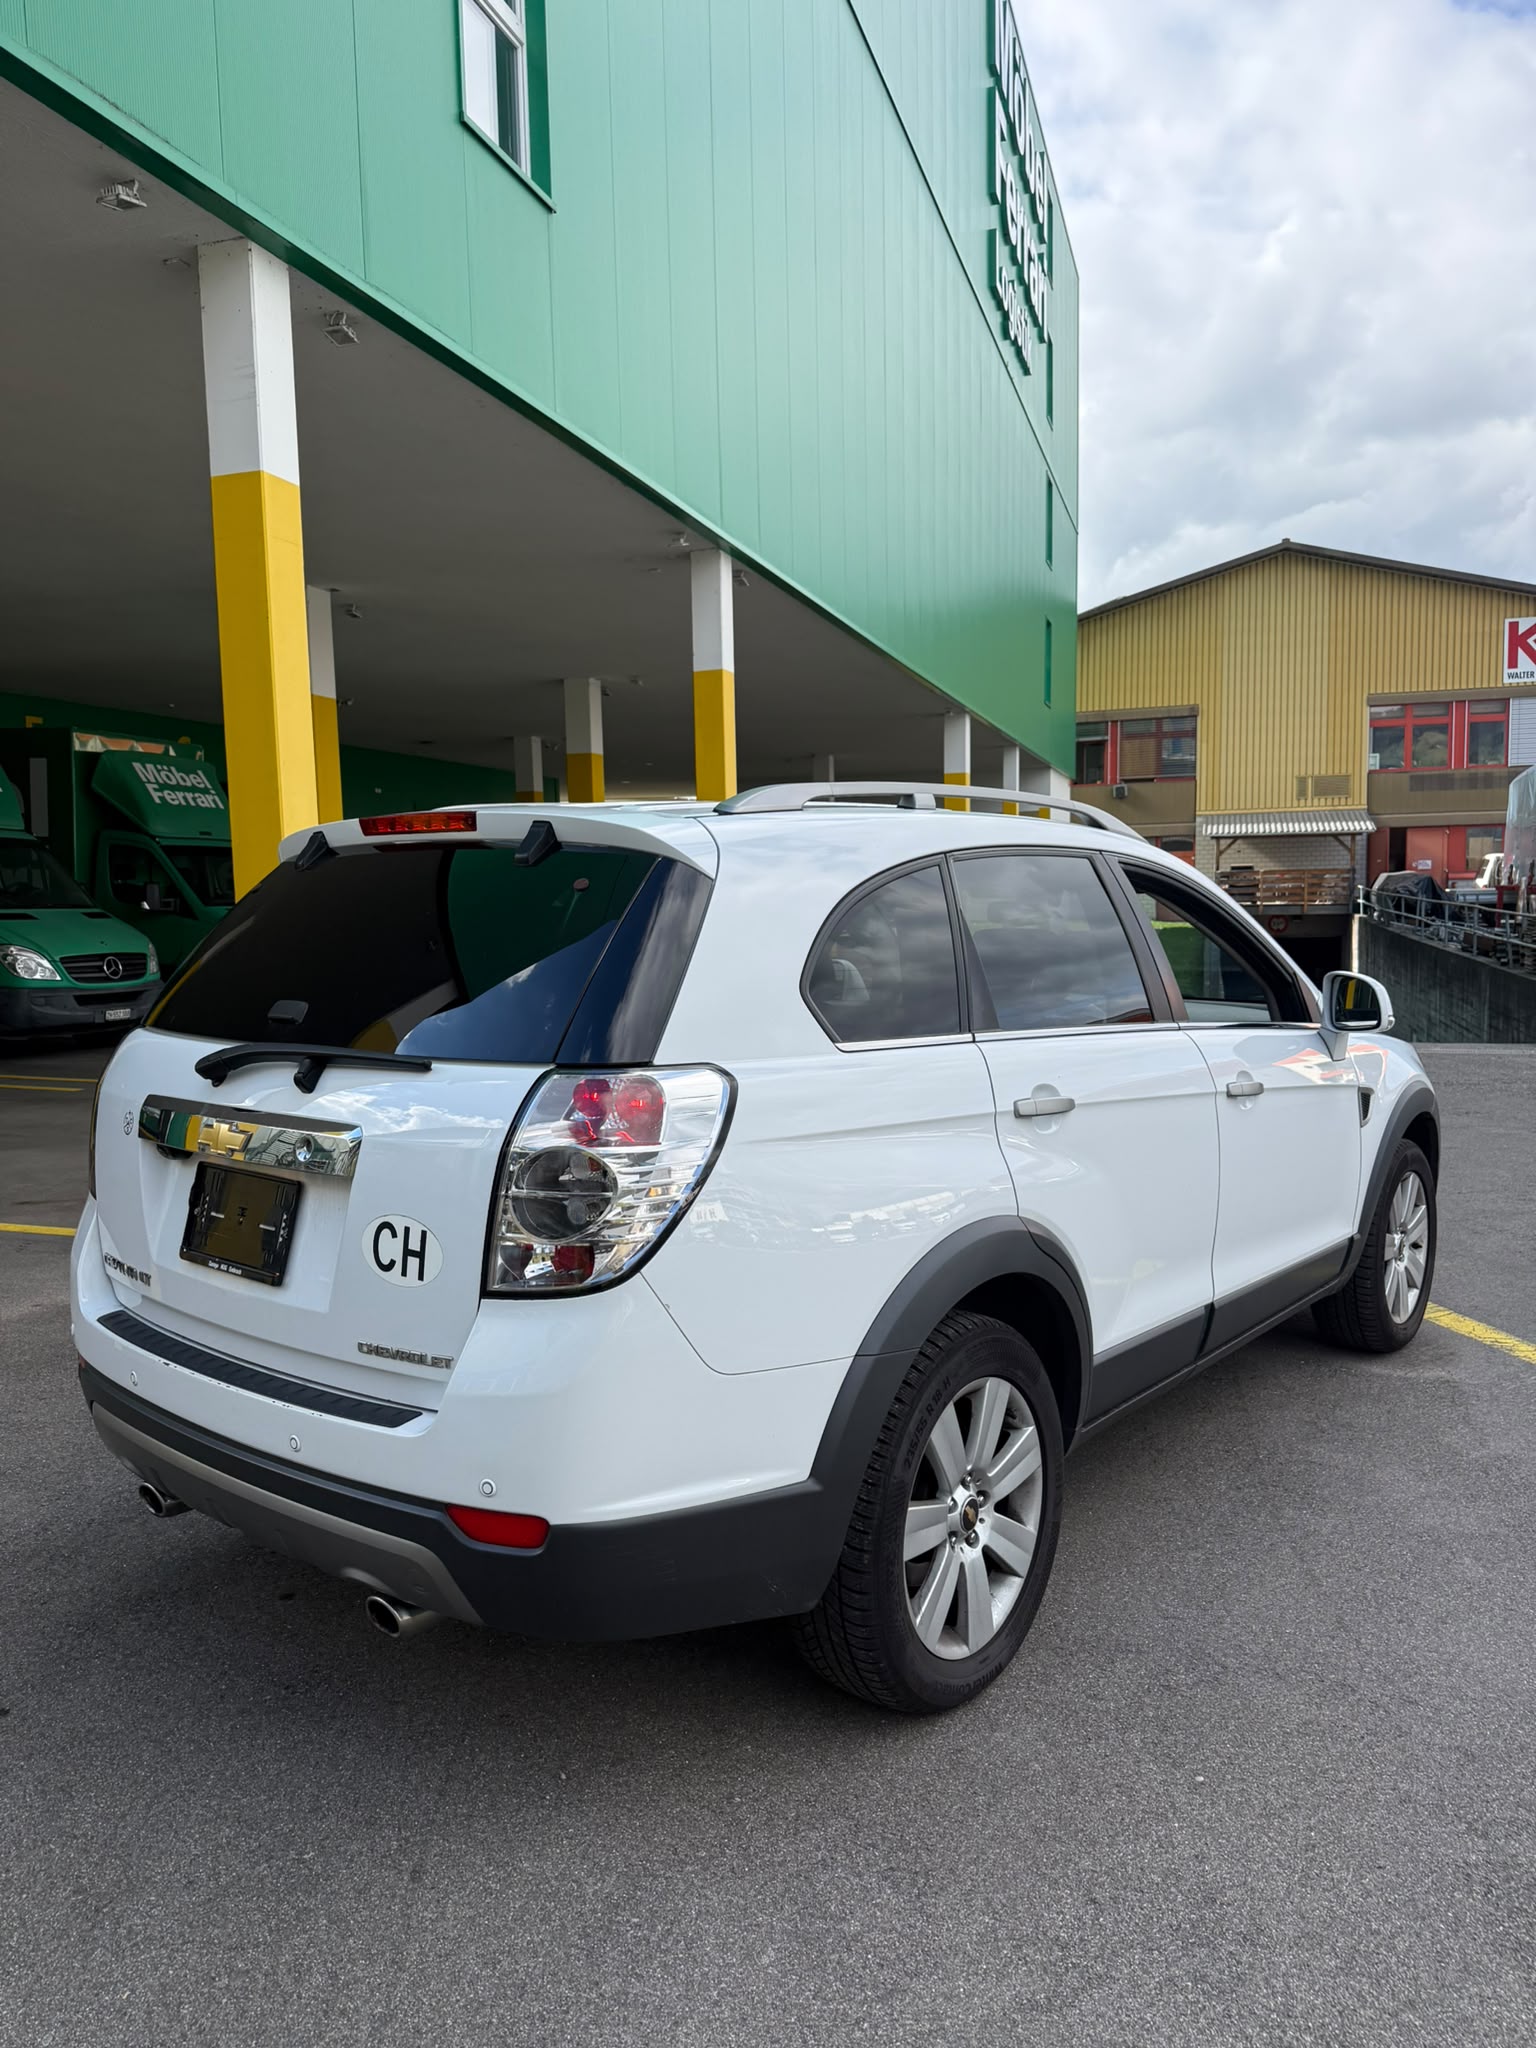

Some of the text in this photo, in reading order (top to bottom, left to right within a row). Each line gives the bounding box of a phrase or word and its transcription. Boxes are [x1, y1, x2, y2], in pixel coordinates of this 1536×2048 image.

[994, 0, 1048, 243] Möbel
[994, 86, 1048, 343] Ferrari
[995, 229, 1032, 375] Logistik
[1507, 671, 1535, 680] WALTER
[132, 762, 212, 789] Möbel
[144, 783, 225, 809] Ferrari
[373, 1221, 427, 1282] CH
[357, 1340, 454, 1369] CHEVROLET
